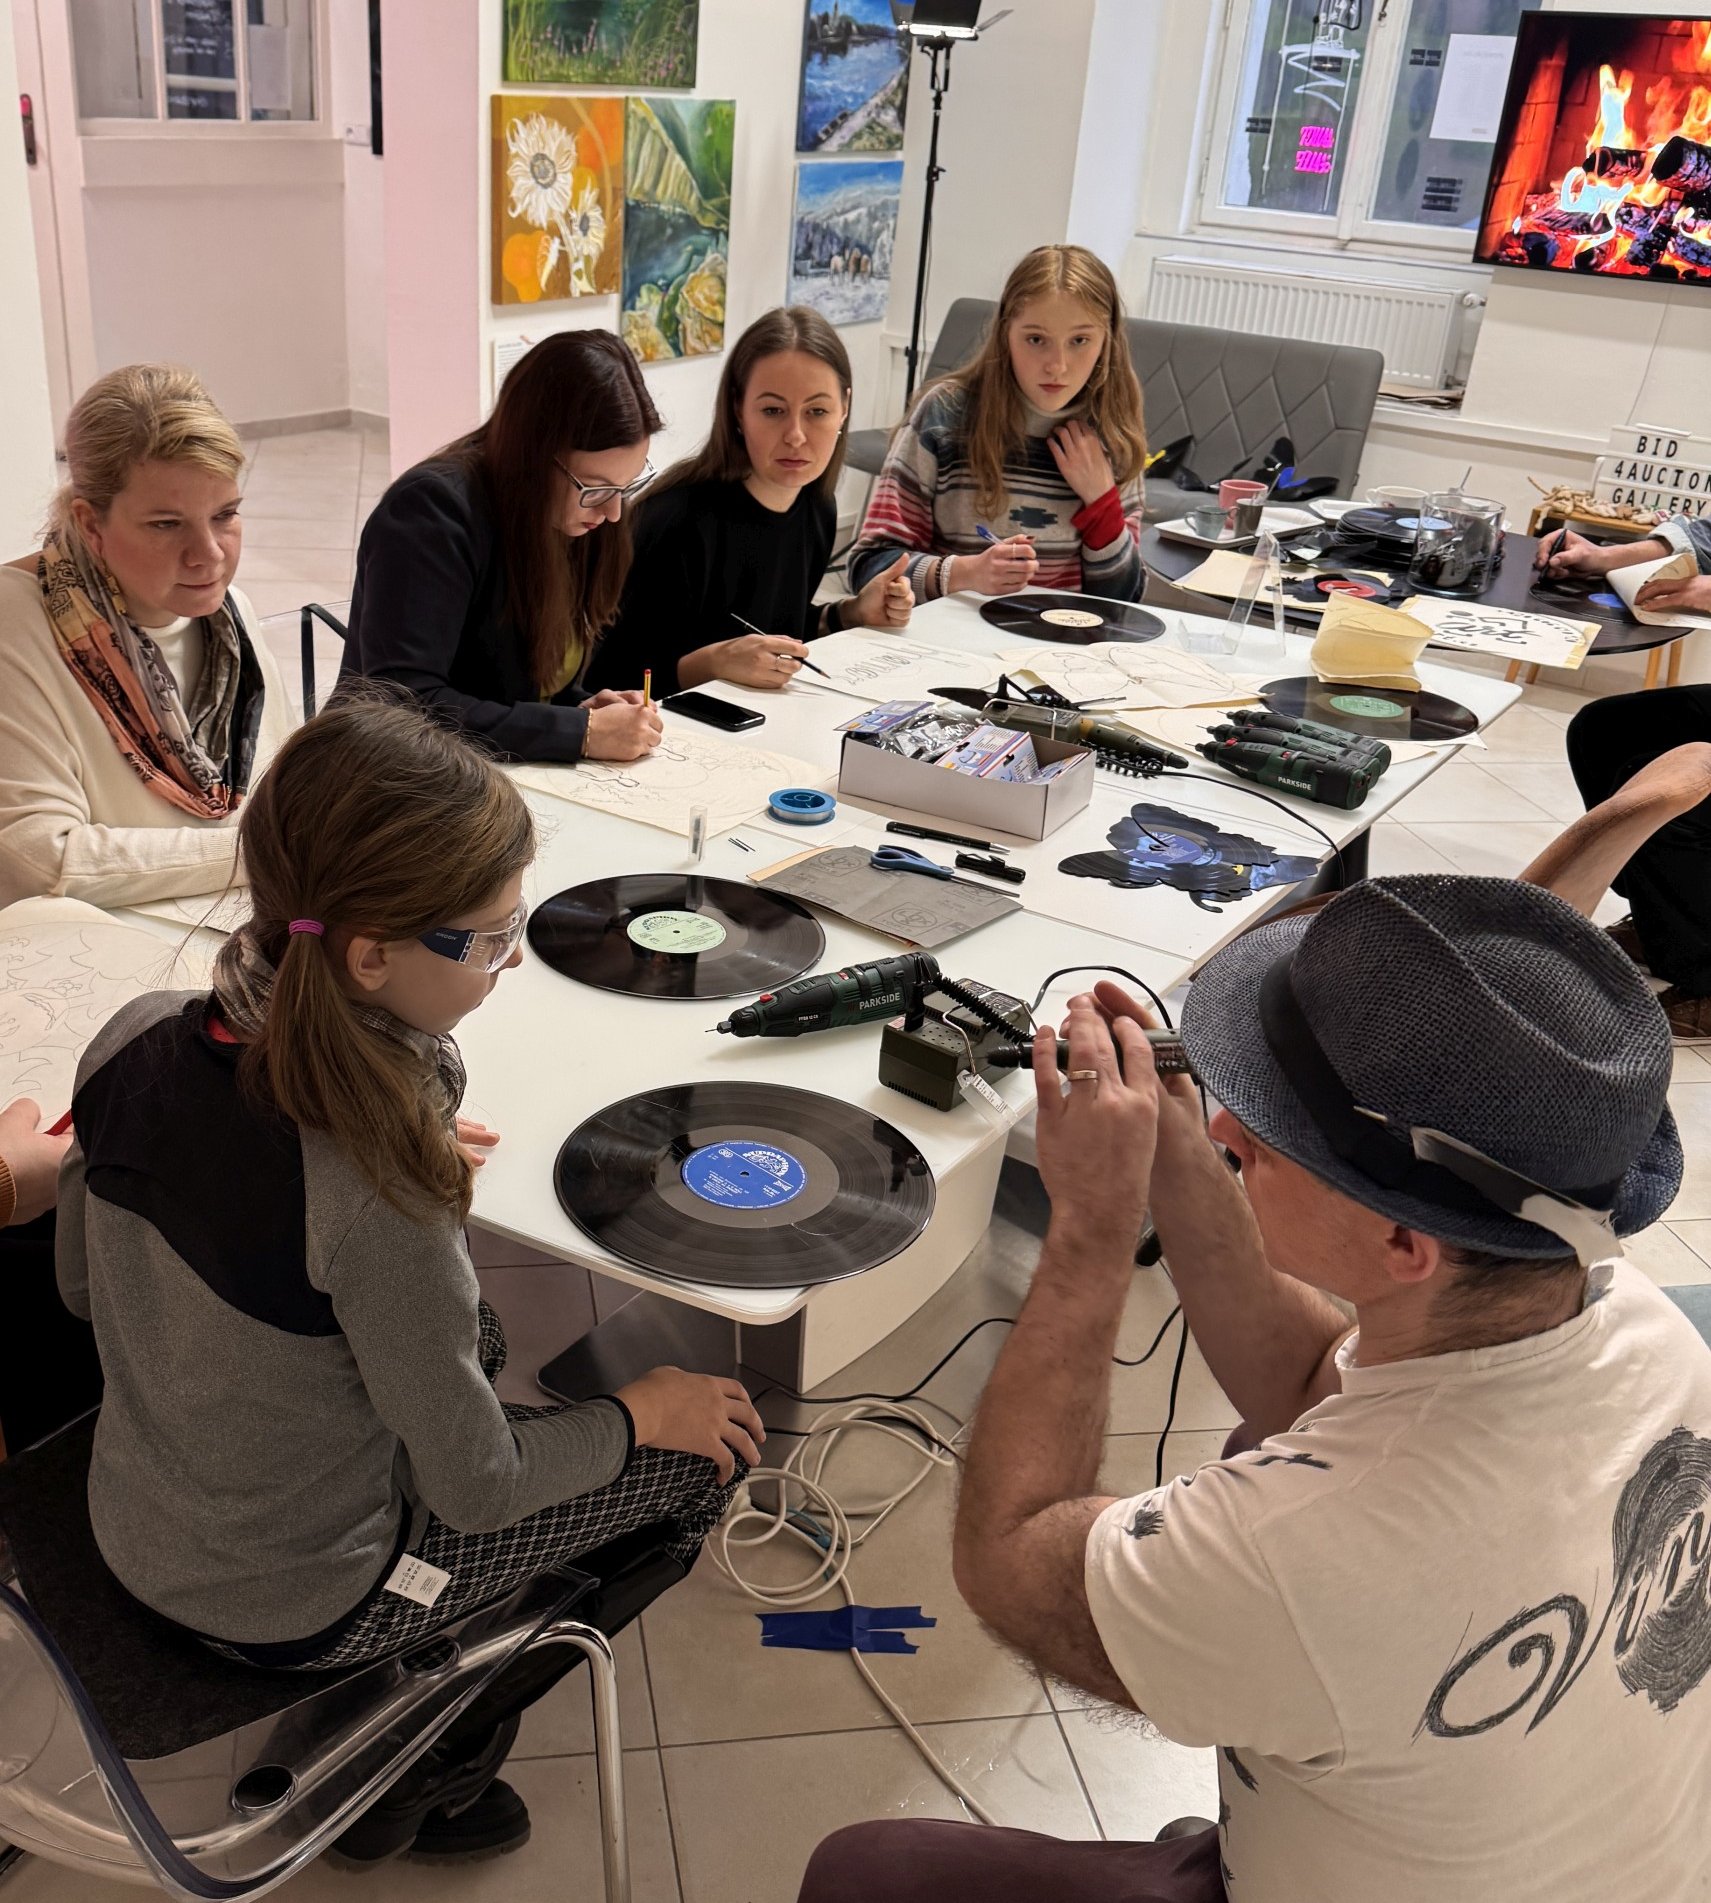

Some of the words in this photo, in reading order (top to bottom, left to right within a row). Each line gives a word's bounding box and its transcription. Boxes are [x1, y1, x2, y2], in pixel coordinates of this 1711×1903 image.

[1636, 435, 1679, 458] BID
[1277, 776, 1313, 791] PARKSIDE
[859, 991, 901, 1010] PARKSIDE
